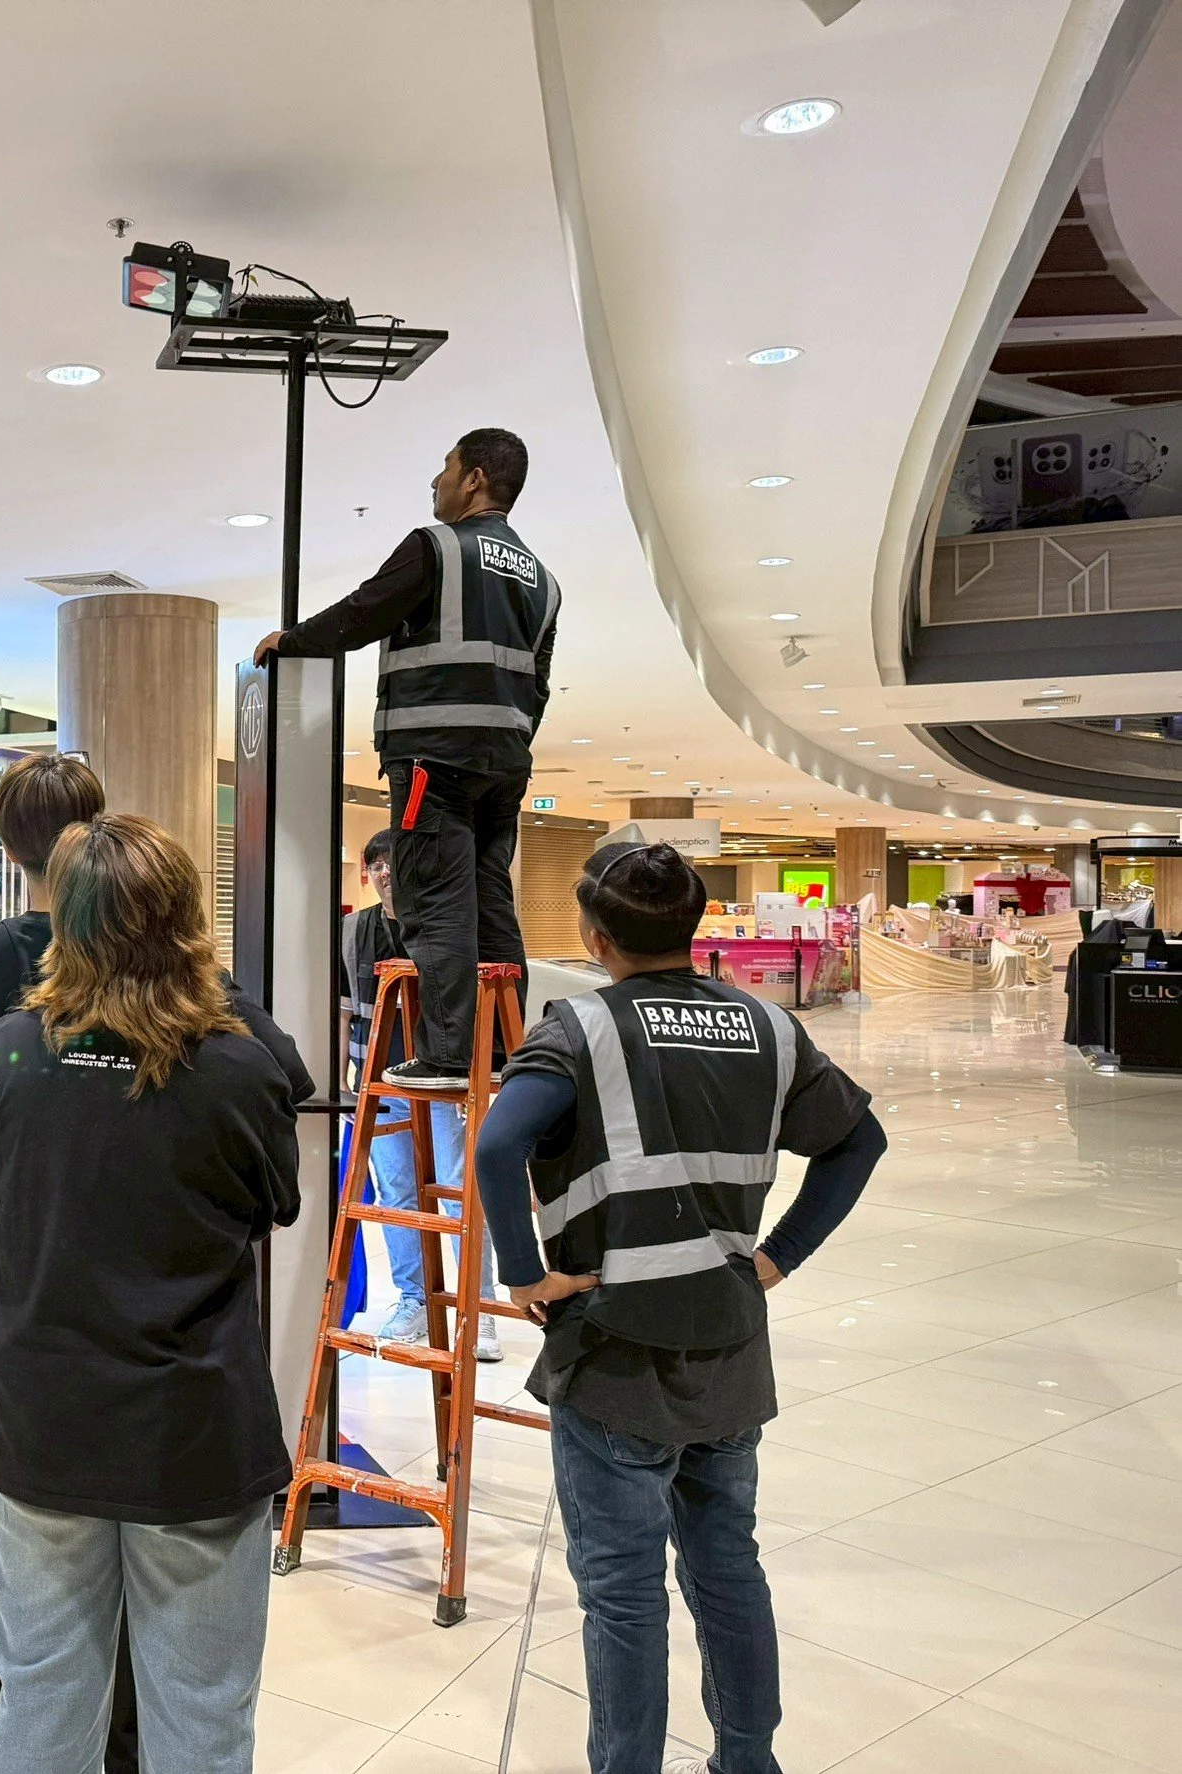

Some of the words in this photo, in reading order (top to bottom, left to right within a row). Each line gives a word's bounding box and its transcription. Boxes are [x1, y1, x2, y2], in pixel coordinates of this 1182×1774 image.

[483, 542, 534, 572] BRANCH
[484, 554, 535, 580] PRODUCTION
[644, 1006, 748, 1029] BRANCH
[650, 1024, 751, 1042] PRODUCTION
[61, 1058, 108, 1068] UNREQUITED
[68, 1052, 97, 1060] LOVING
